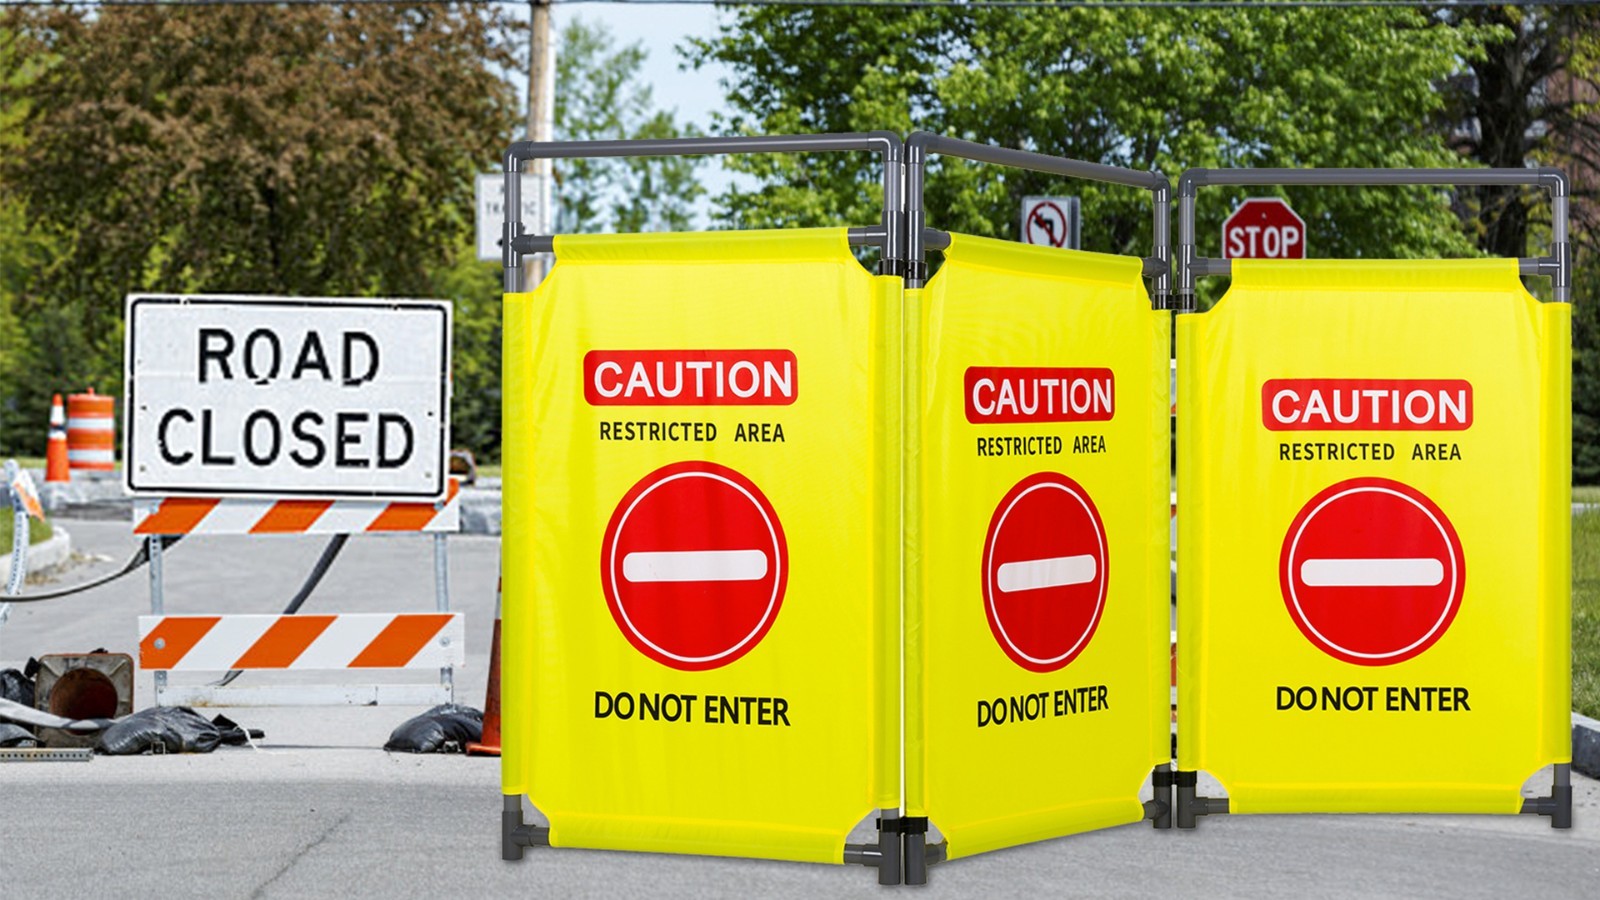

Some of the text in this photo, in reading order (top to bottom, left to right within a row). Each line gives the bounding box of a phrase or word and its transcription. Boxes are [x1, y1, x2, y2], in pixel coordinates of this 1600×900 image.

[1228, 227, 1300, 258] STOP
[198, 328, 380, 386] ROAD
[593, 360, 793, 398] CAUTION
[972, 377, 1113, 416] CAUTION
[1271, 389, 1467, 424] CAUTION
[157, 408, 414, 469] CLOSED
[599, 421, 786, 443] RESTRICTED AREA
[977, 435, 1107, 457] RESTRICTED AREA
[1279, 442, 1462, 461] RESTRICTED AREA
[594, 691, 791, 727] DO NOT ENTER
[977, 685, 1109, 728] DO NOT ENTER
[1276, 686, 1471, 712] DO NOT ENTER
